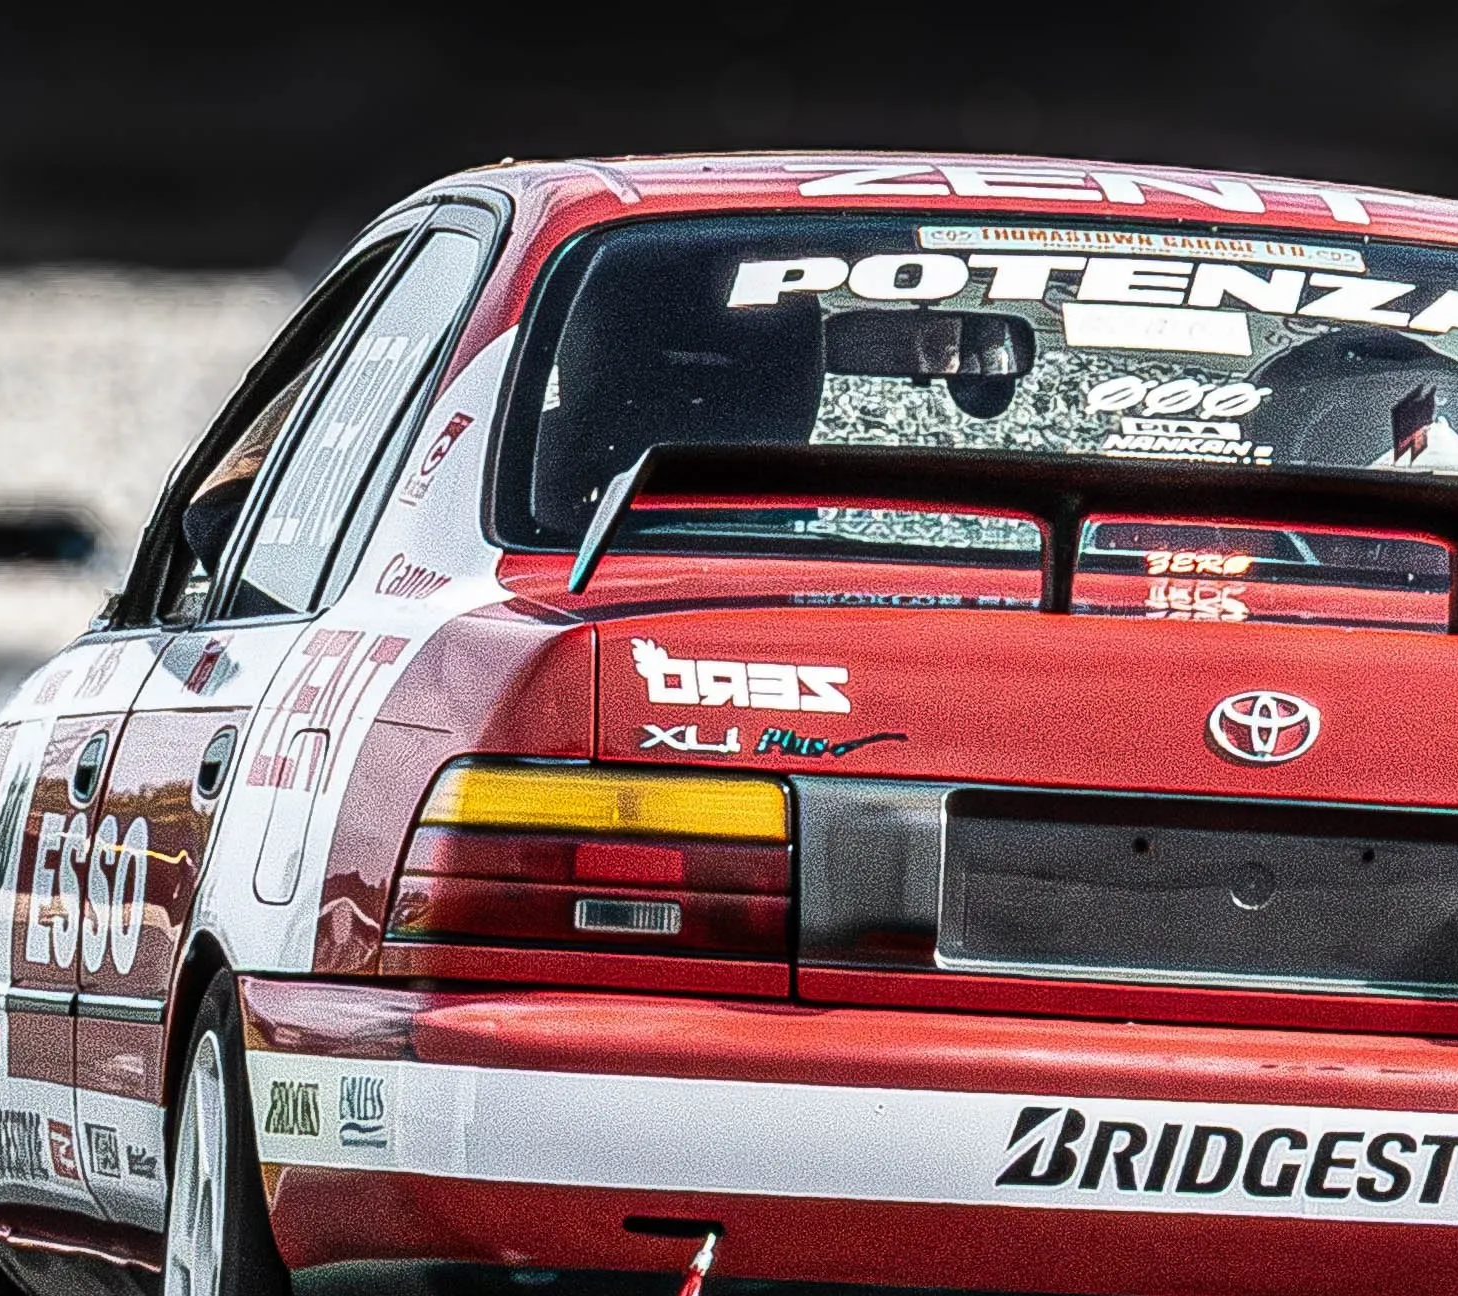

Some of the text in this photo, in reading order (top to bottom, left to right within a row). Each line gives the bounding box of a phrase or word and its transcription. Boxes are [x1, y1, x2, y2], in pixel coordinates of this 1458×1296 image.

[785, 163, 1414, 225] ZENT
[1163, 236, 1254, 254] GARAGE
[25, 811, 149, 976] ESSO
